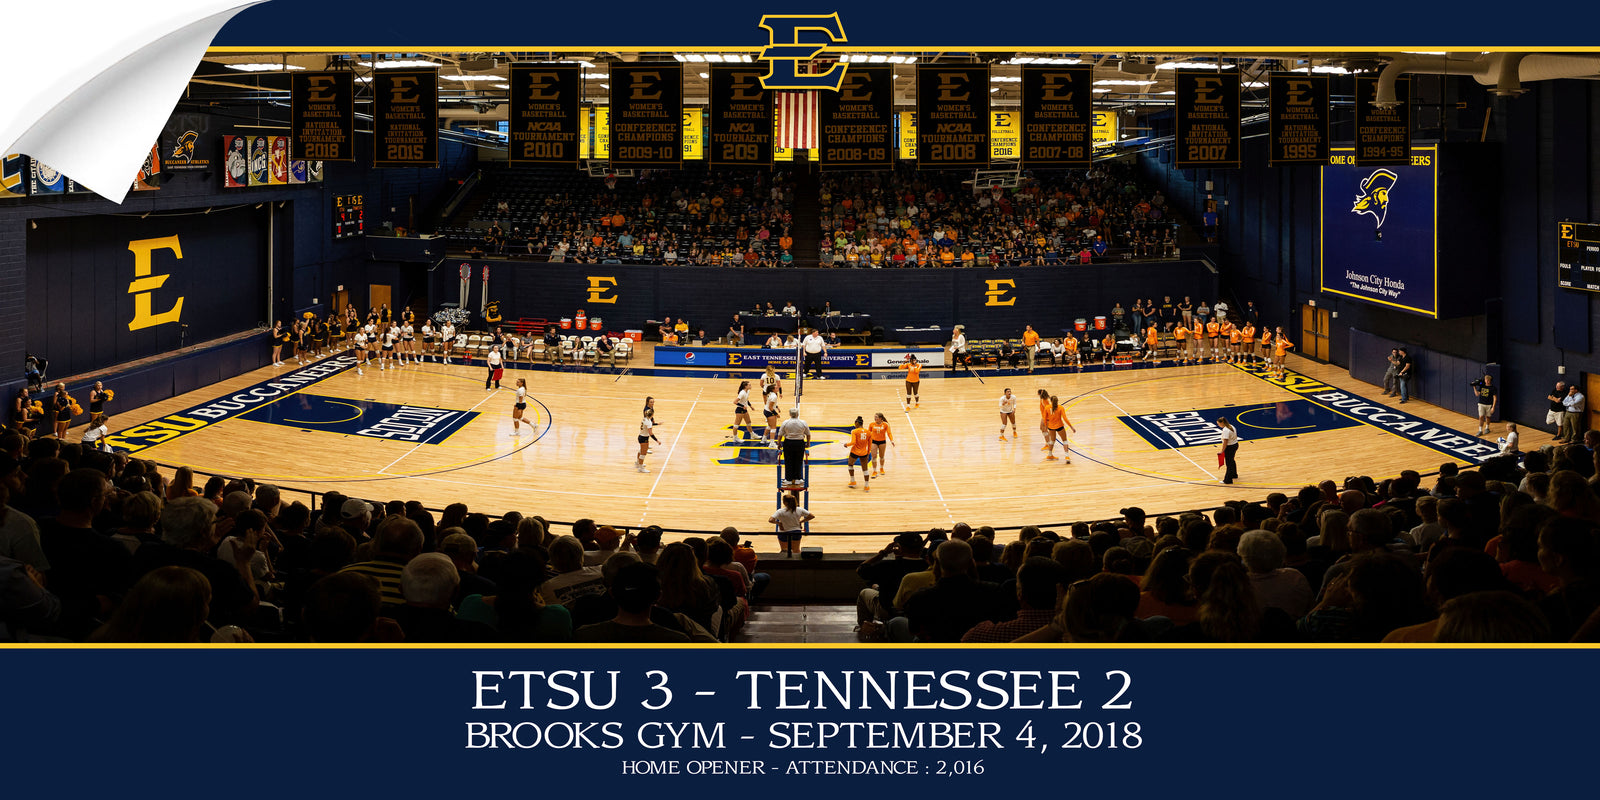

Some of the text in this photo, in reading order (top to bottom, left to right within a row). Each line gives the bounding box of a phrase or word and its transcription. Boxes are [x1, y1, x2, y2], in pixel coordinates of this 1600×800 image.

[527, 122, 562, 131] NCAA
[615, 123, 677, 132] CONFERENCE
[825, 125, 888, 133] CONFERENCE
[936, 123, 972, 133] NCAA
[1027, 124, 1087, 132] CONFERENCE
[513, 132, 575, 141] TOURNAMENT
[618, 133, 674, 141] CHAMPIONS
[828, 134, 885, 143] CHAMPIONS
[922, 134, 986, 143] TOURNAMENT
[1030, 133, 1084, 141] CHAMPIONS
[305, 143, 339, 158] 2018
[388, 145, 424, 160] 2015
[524, 142, 563, 158] 2010
[619, 147, 673, 159] 2009-10
[828, 148, 886, 160] 2008-09
[931, 144, 976, 160] 2008
[1029, 147, 1084, 158] 2007-08
[1189, 146, 1228, 160] 2007
[1283, 144, 1317, 159] 1995
[1363, 147, 1404, 157] 1994-95
[1330, 155, 1346, 165] OME
[1561, 224, 1573, 240] E
[126, 234, 185, 331] E
[1346, 270, 1405, 290] Johnson City Honda
[586, 276, 618, 305] E
[984, 278, 1016, 306] E
[97, 355, 357, 452] TSU BUCCANEERS
[1313, 391, 1504, 462] BUCCANEE
